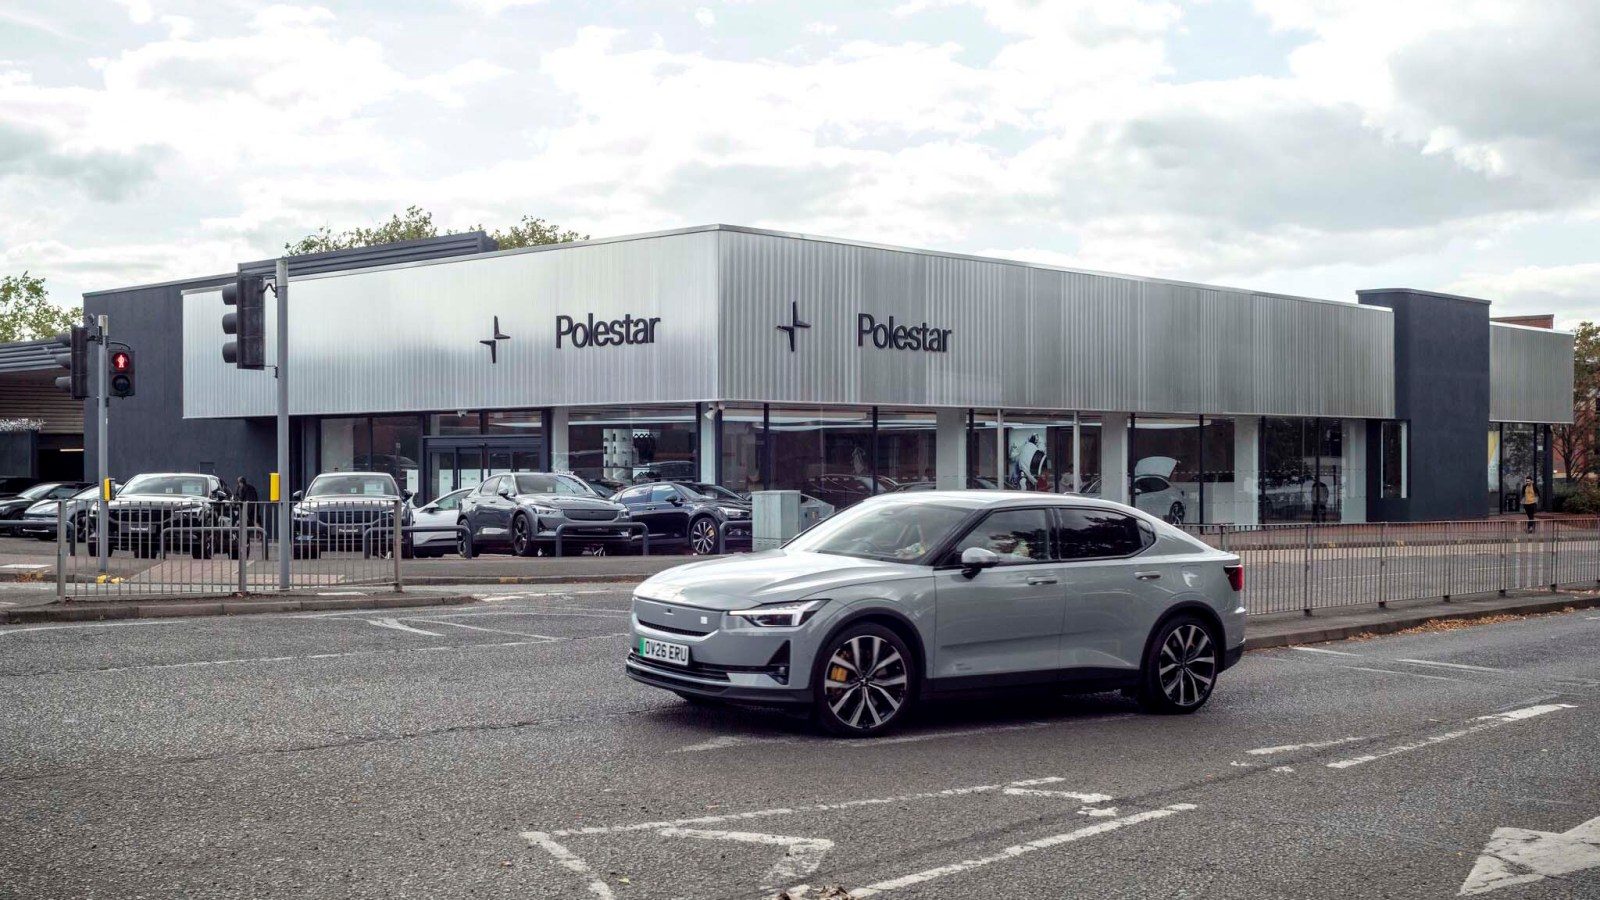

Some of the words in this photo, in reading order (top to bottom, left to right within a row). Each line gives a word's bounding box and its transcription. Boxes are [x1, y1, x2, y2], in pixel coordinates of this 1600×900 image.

[556, 313, 661, 349] Polestar
[858, 313, 952, 352] Polestar
[669, 645, 687, 662] ERU
